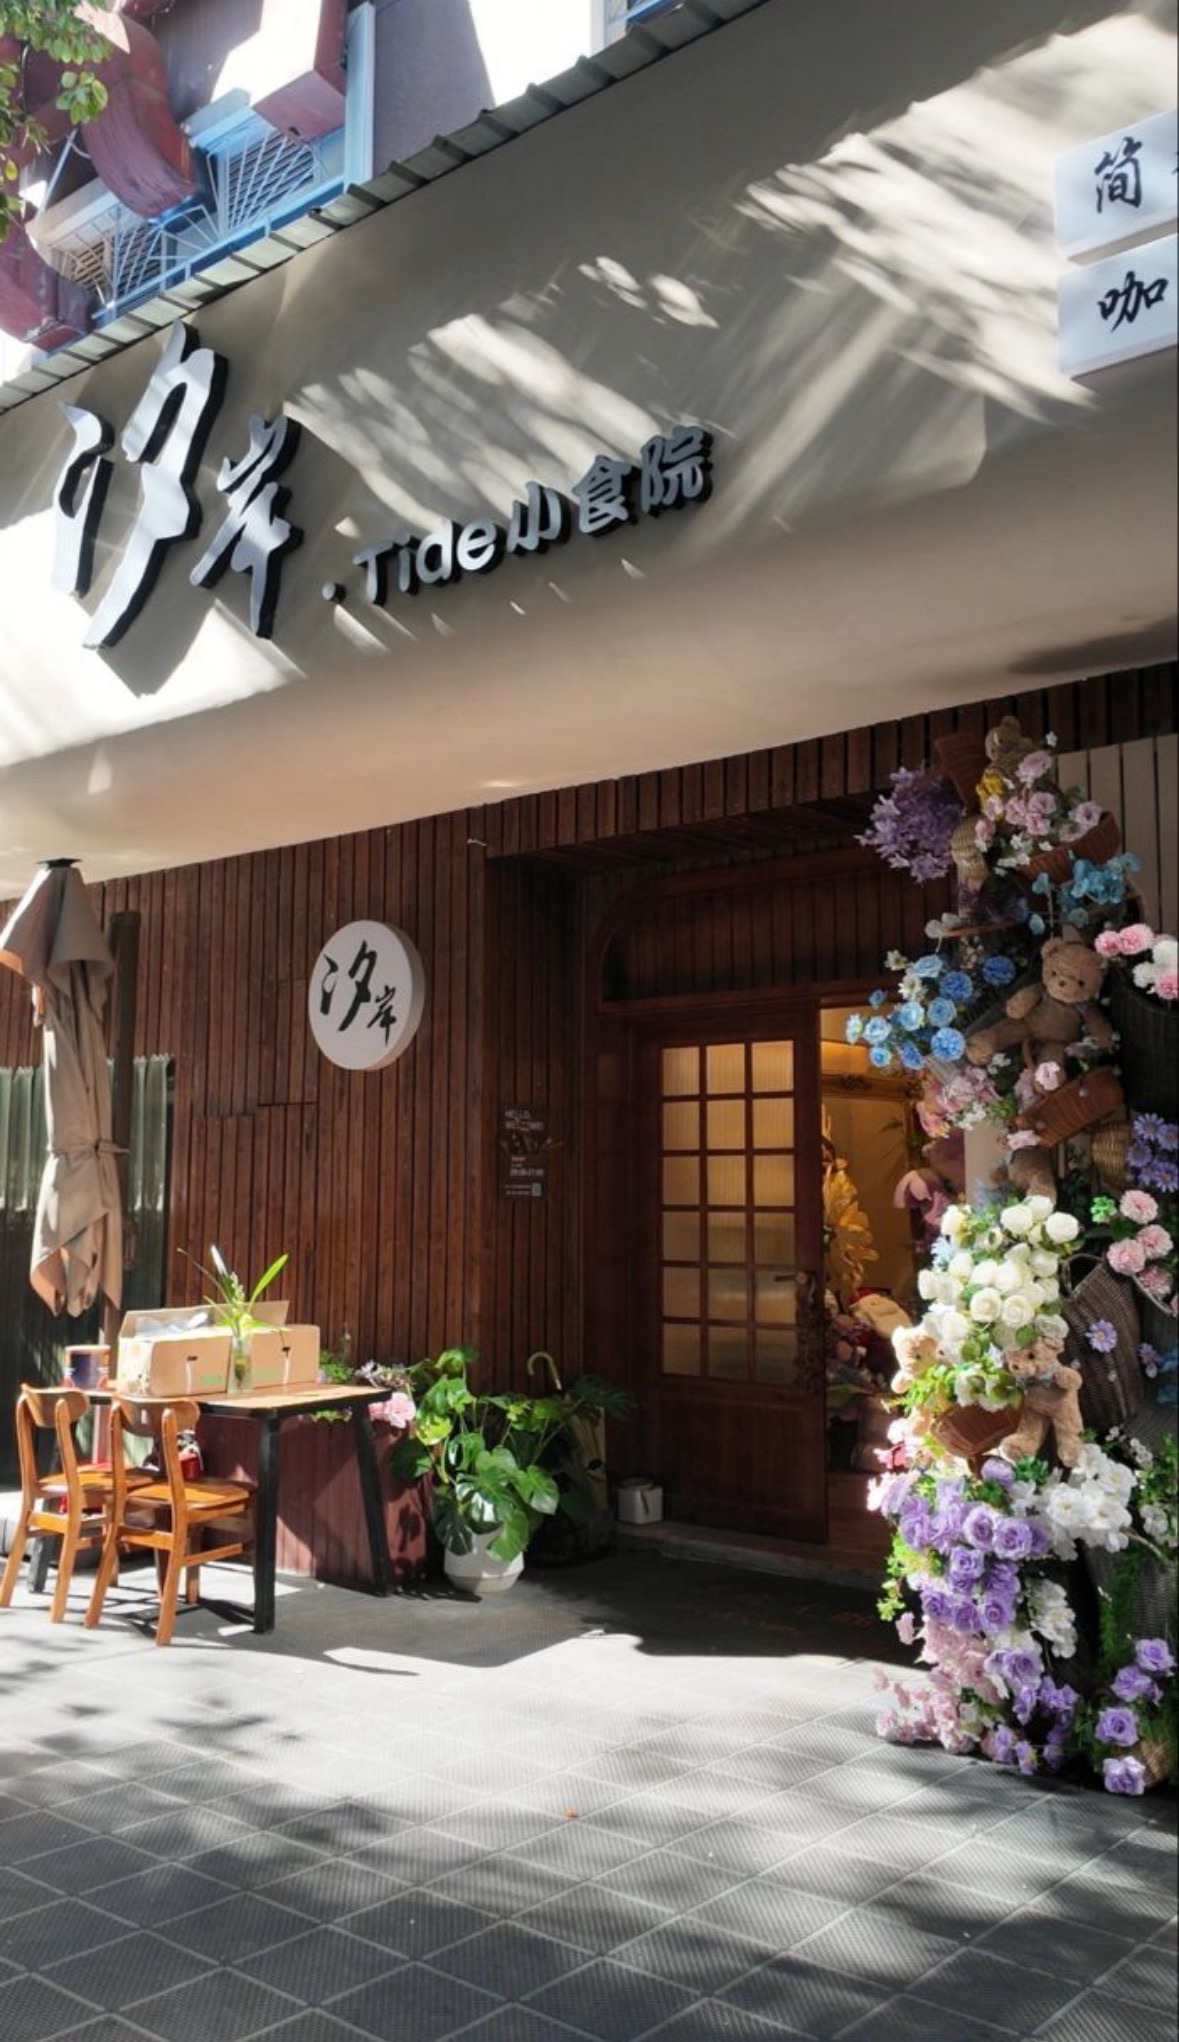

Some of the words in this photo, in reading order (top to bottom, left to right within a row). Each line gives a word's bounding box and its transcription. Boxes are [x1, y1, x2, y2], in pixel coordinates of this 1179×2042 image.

[1097, 270, 1169, 332] 咖
[52, 319, 304, 649] 汐岸
[320, 940, 397, 1047] 汐岸
